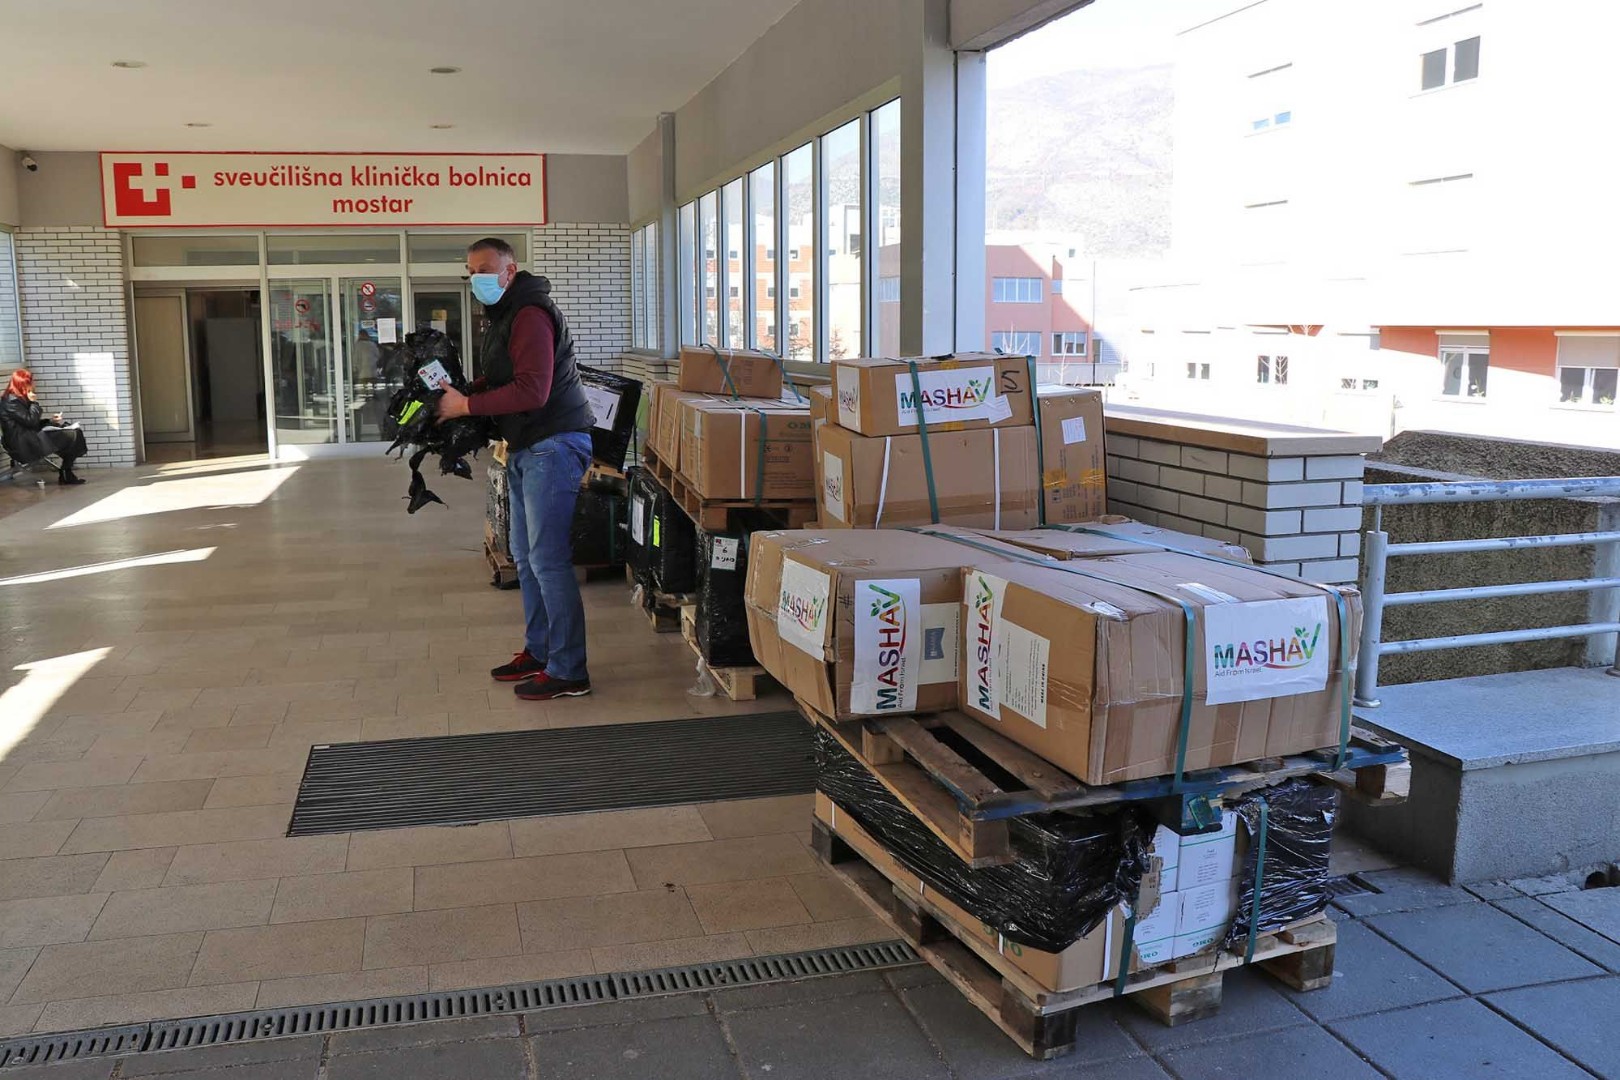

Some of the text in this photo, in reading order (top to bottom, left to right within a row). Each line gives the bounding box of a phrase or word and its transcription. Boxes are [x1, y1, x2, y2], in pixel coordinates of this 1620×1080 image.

[214, 165, 531, 187] sveučilišna klinička bolnica
[333, 195, 413, 213] mostar
[900, 376, 992, 409] MASHAV
[781, 590, 825, 628] MASHAV
[868, 583, 901, 710] MASHAV
[977, 575, 993, 710] MASHAV
[1214, 623, 1321, 669] MASHAV
[1215, 666, 1262, 677] Aid From Israel
